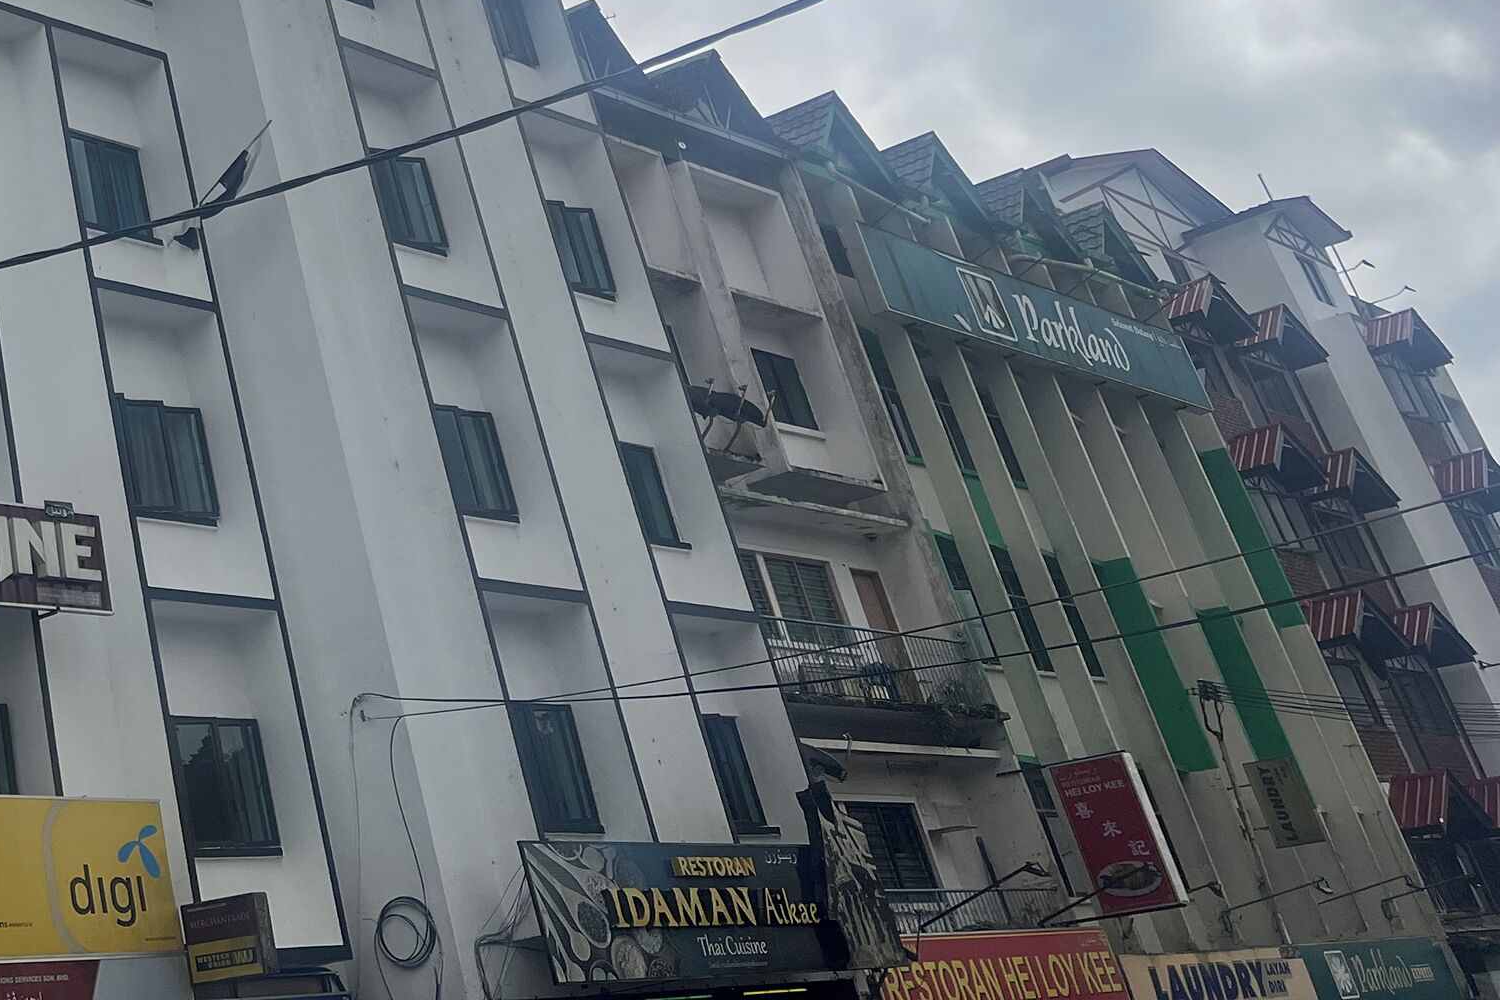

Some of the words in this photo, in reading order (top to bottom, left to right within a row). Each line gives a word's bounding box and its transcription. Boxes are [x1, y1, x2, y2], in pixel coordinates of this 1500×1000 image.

[1012, 294, 1130, 371] Parkland
[1064, 786, 1082, 798] HEI
[1082, 783, 1103, 795] LOY
[1104, 779, 1126, 791] KEE
[676, 856, 757, 876] RESTORAN
[69, 864, 148, 928] digi
[610, 886, 757, 929] IDAMAN
[764, 886, 820, 925] Aikae
[697, 933, 726, 957] Thai
[725, 935, 768, 956] Cuisine
[14, 975, 43, 984] SERVICES
[884, 959, 1004, 1000] RESTORAN
[999, 955, 1042, 1000] HEI
[1035, 953, 1080, 998] LOY
[1076, 950, 1124, 994] KEE
[1148, 960, 1268, 1000] LAUNDRY
[1263, 961, 1291, 976] LAYAN
[1350, 948, 1414, 995] Parkland
[1267, 980, 1287, 995] DIRI
